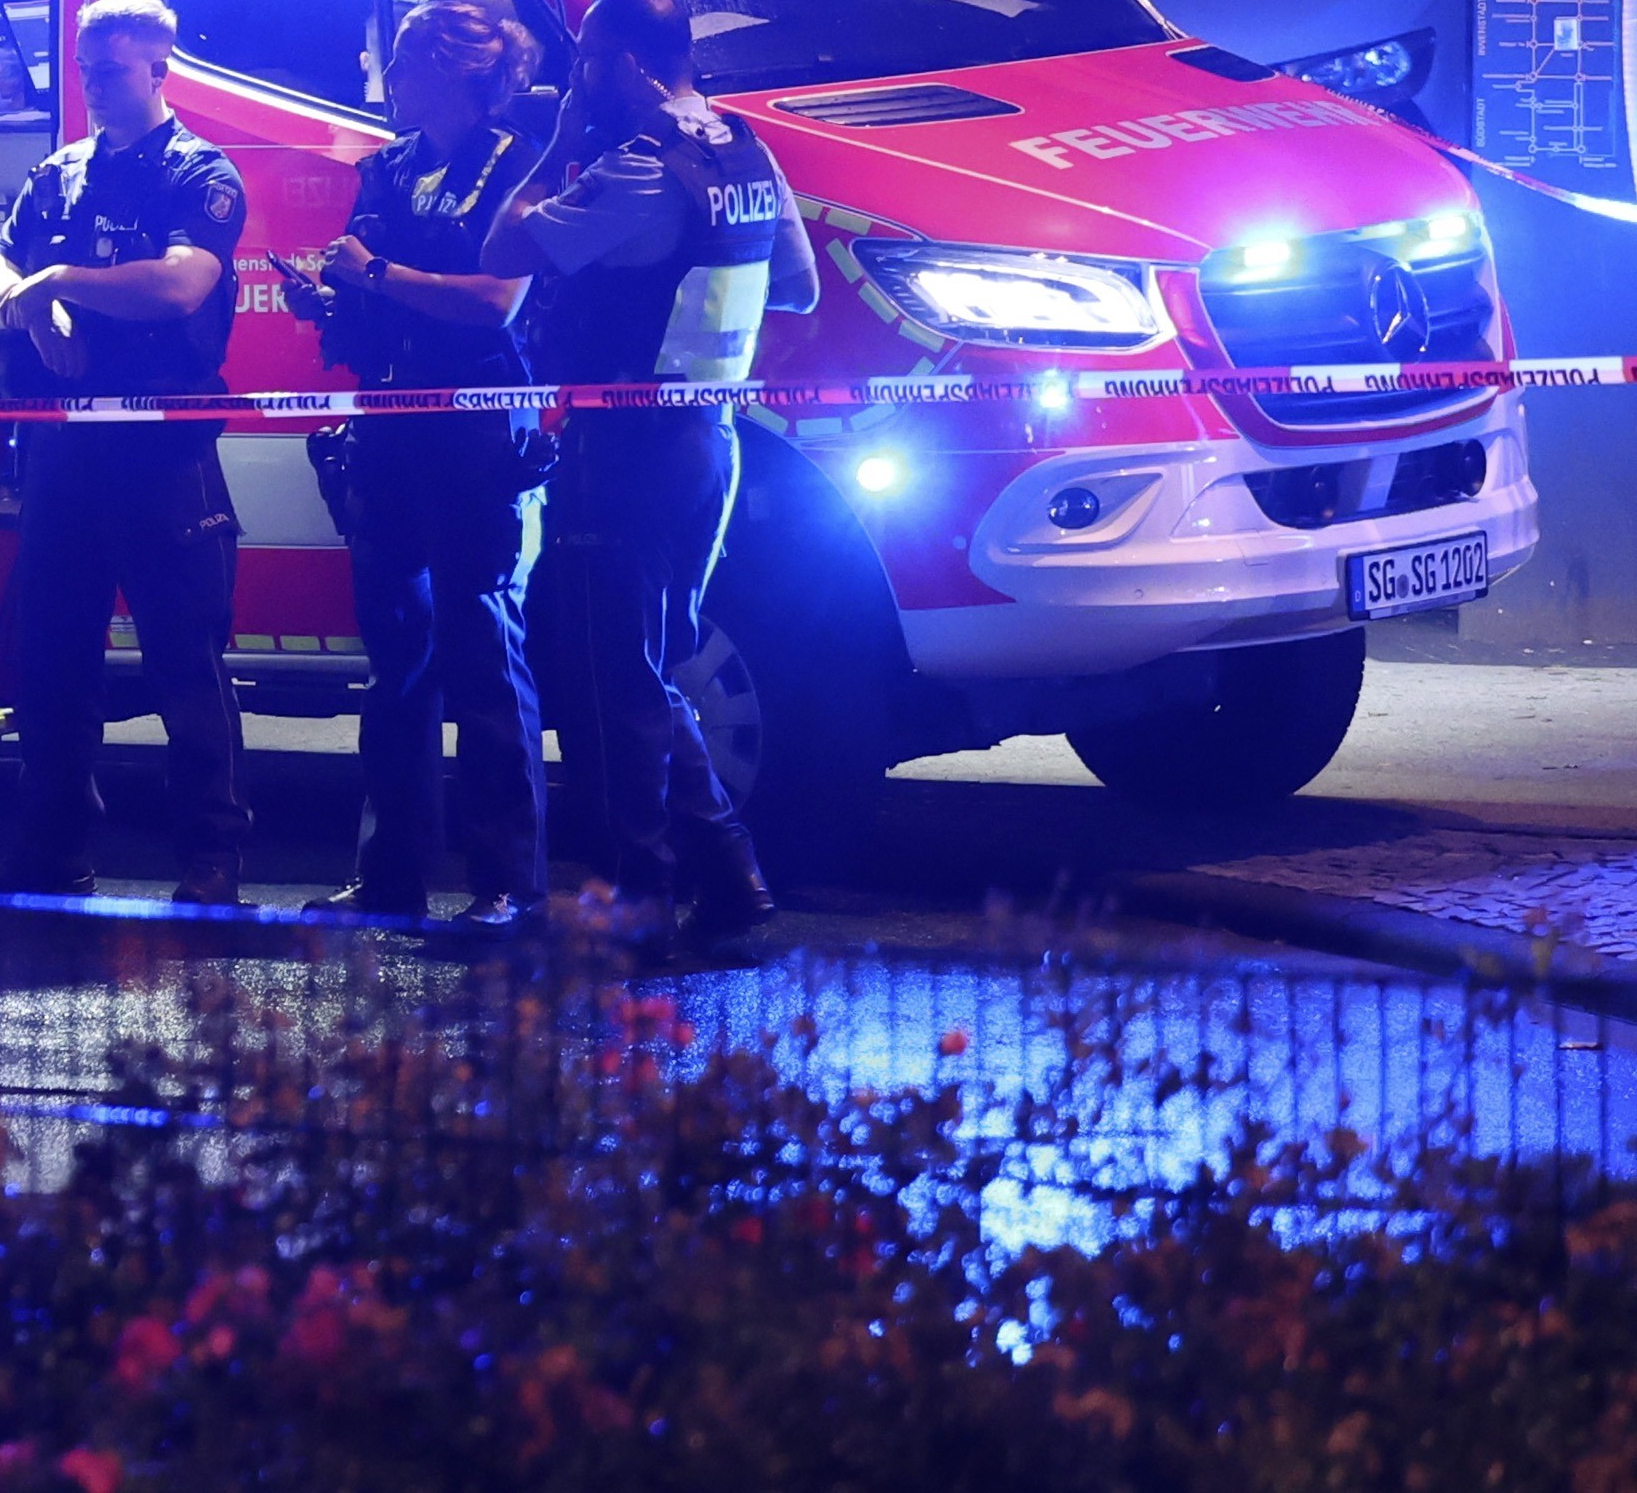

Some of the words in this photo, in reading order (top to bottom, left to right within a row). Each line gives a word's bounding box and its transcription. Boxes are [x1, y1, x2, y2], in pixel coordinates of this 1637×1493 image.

[1008, 100, 1384, 170] FEUERWEHR
[707, 179, 776, 227] POLIZEI
[1368, 558, 1396, 603] SG
[1411, 552, 1437, 595] SG
[1440, 541, 1484, 591] 1202
